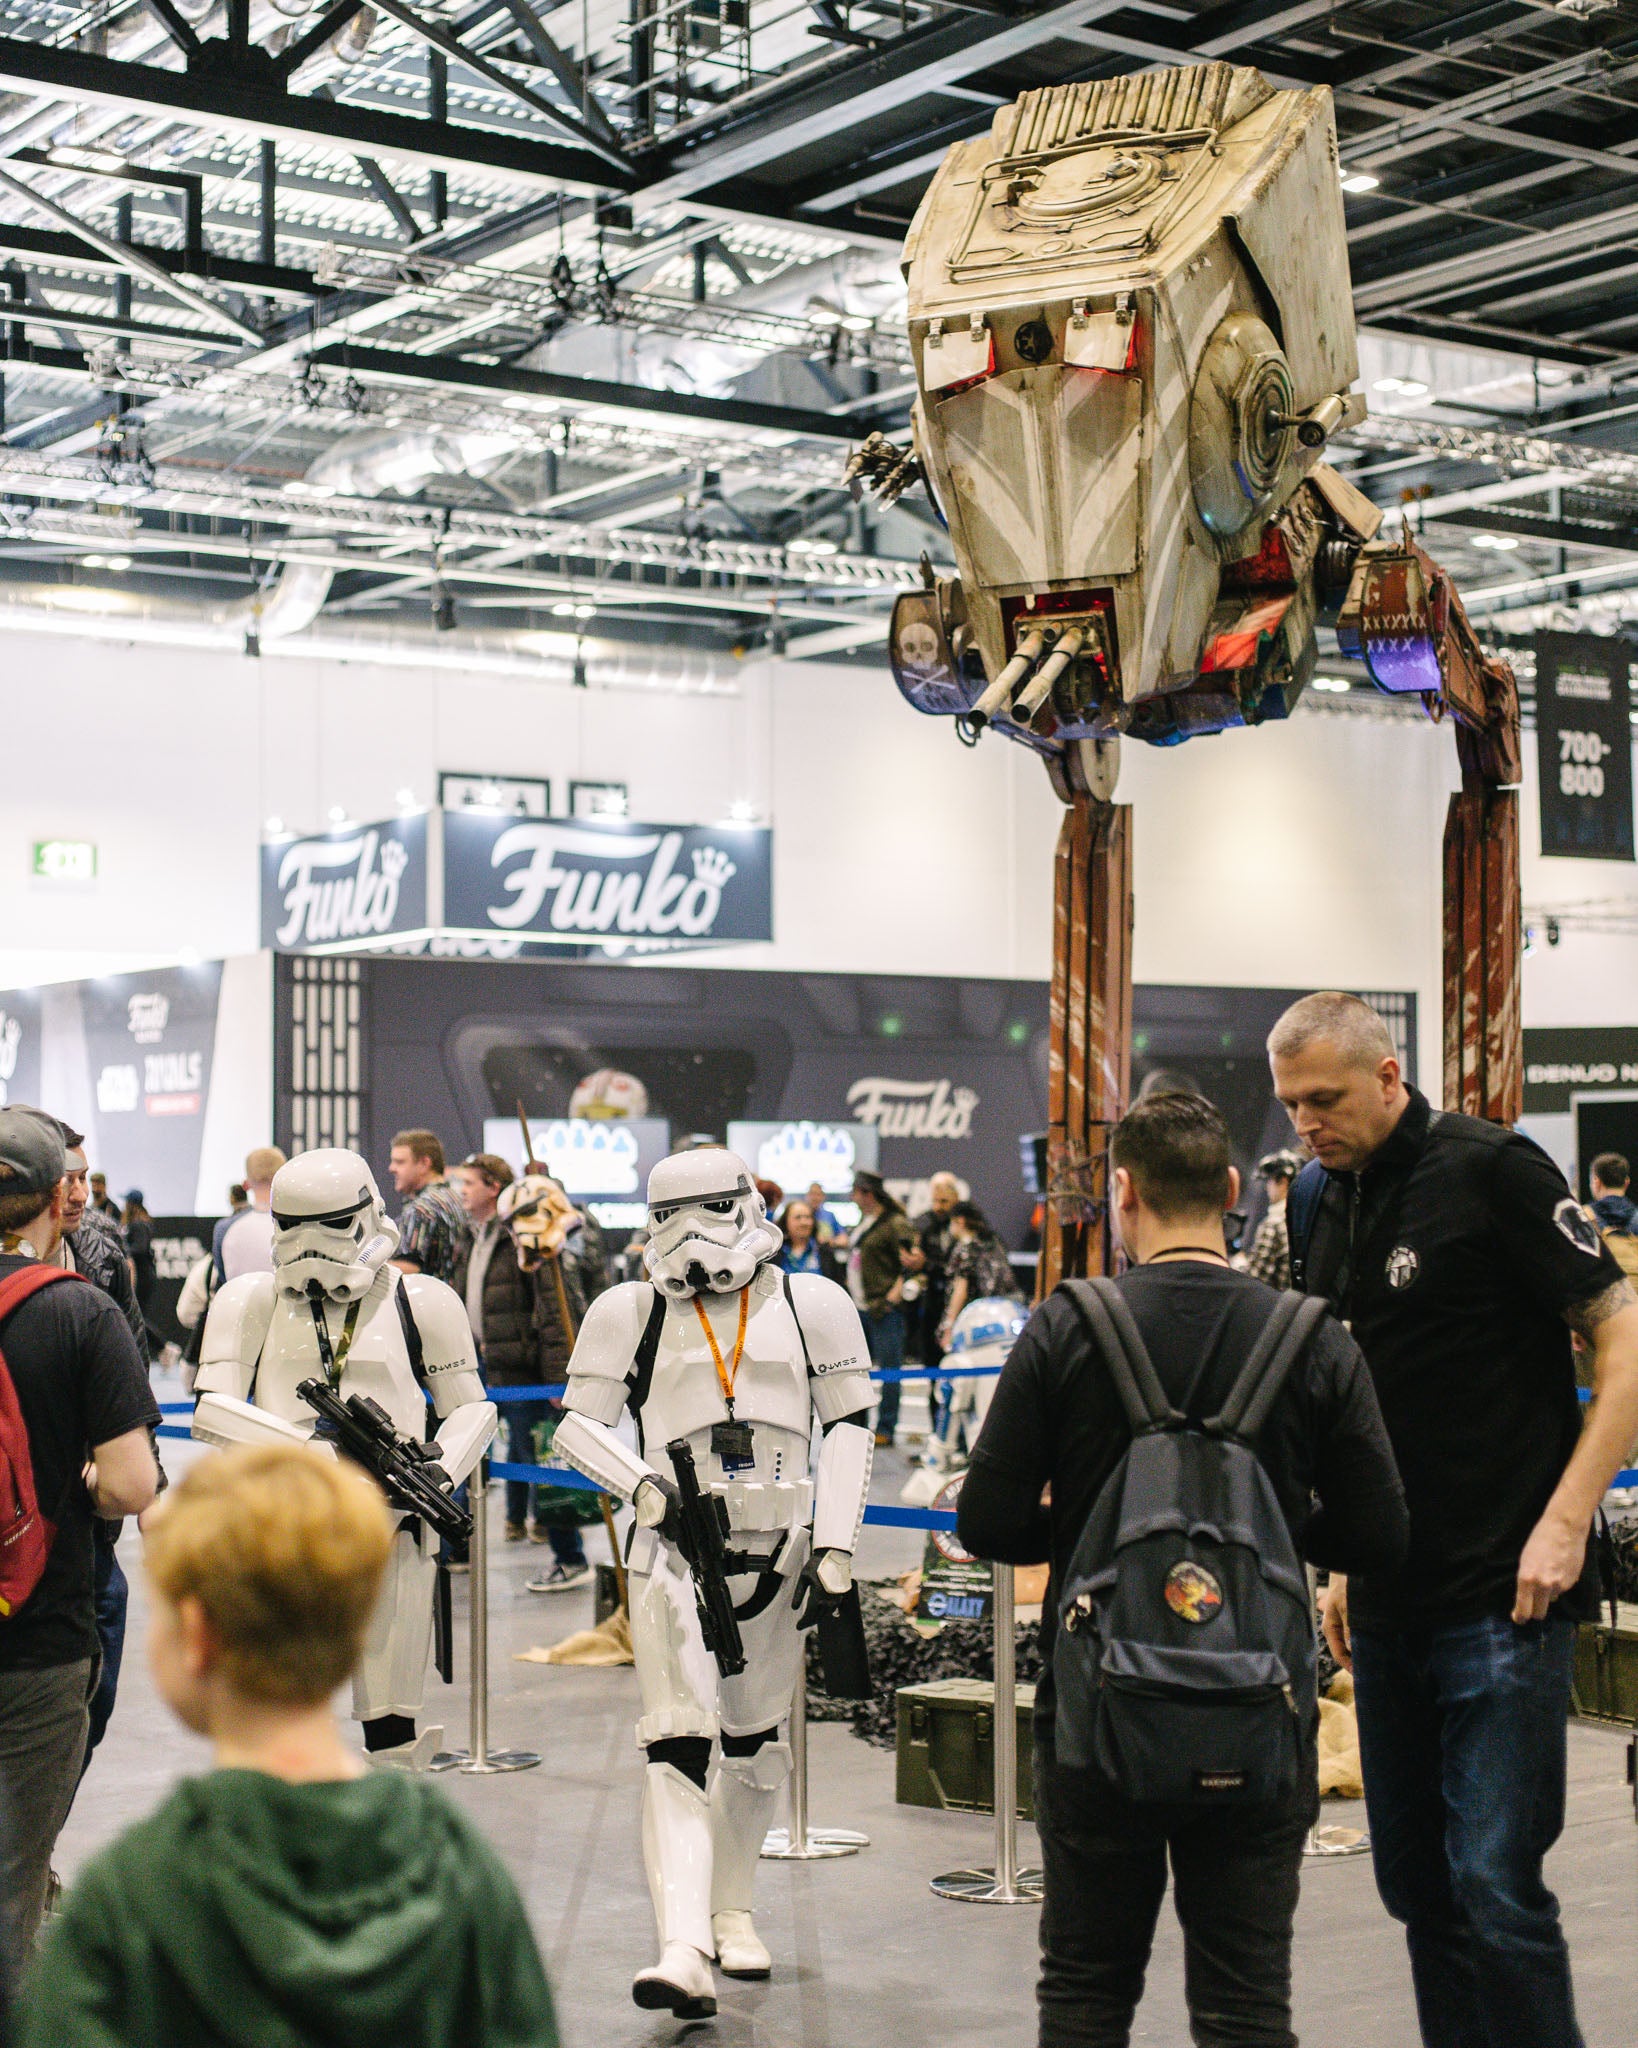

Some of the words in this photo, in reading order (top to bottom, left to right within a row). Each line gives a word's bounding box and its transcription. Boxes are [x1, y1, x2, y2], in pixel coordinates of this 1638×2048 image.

[1558, 729, 1612, 765] 700-
[1560, 762, 1605, 798] 800
[277, 829, 407, 947] Funko
[487, 823, 722, 936] Funko
[848, 1077, 972, 1139] Funko
